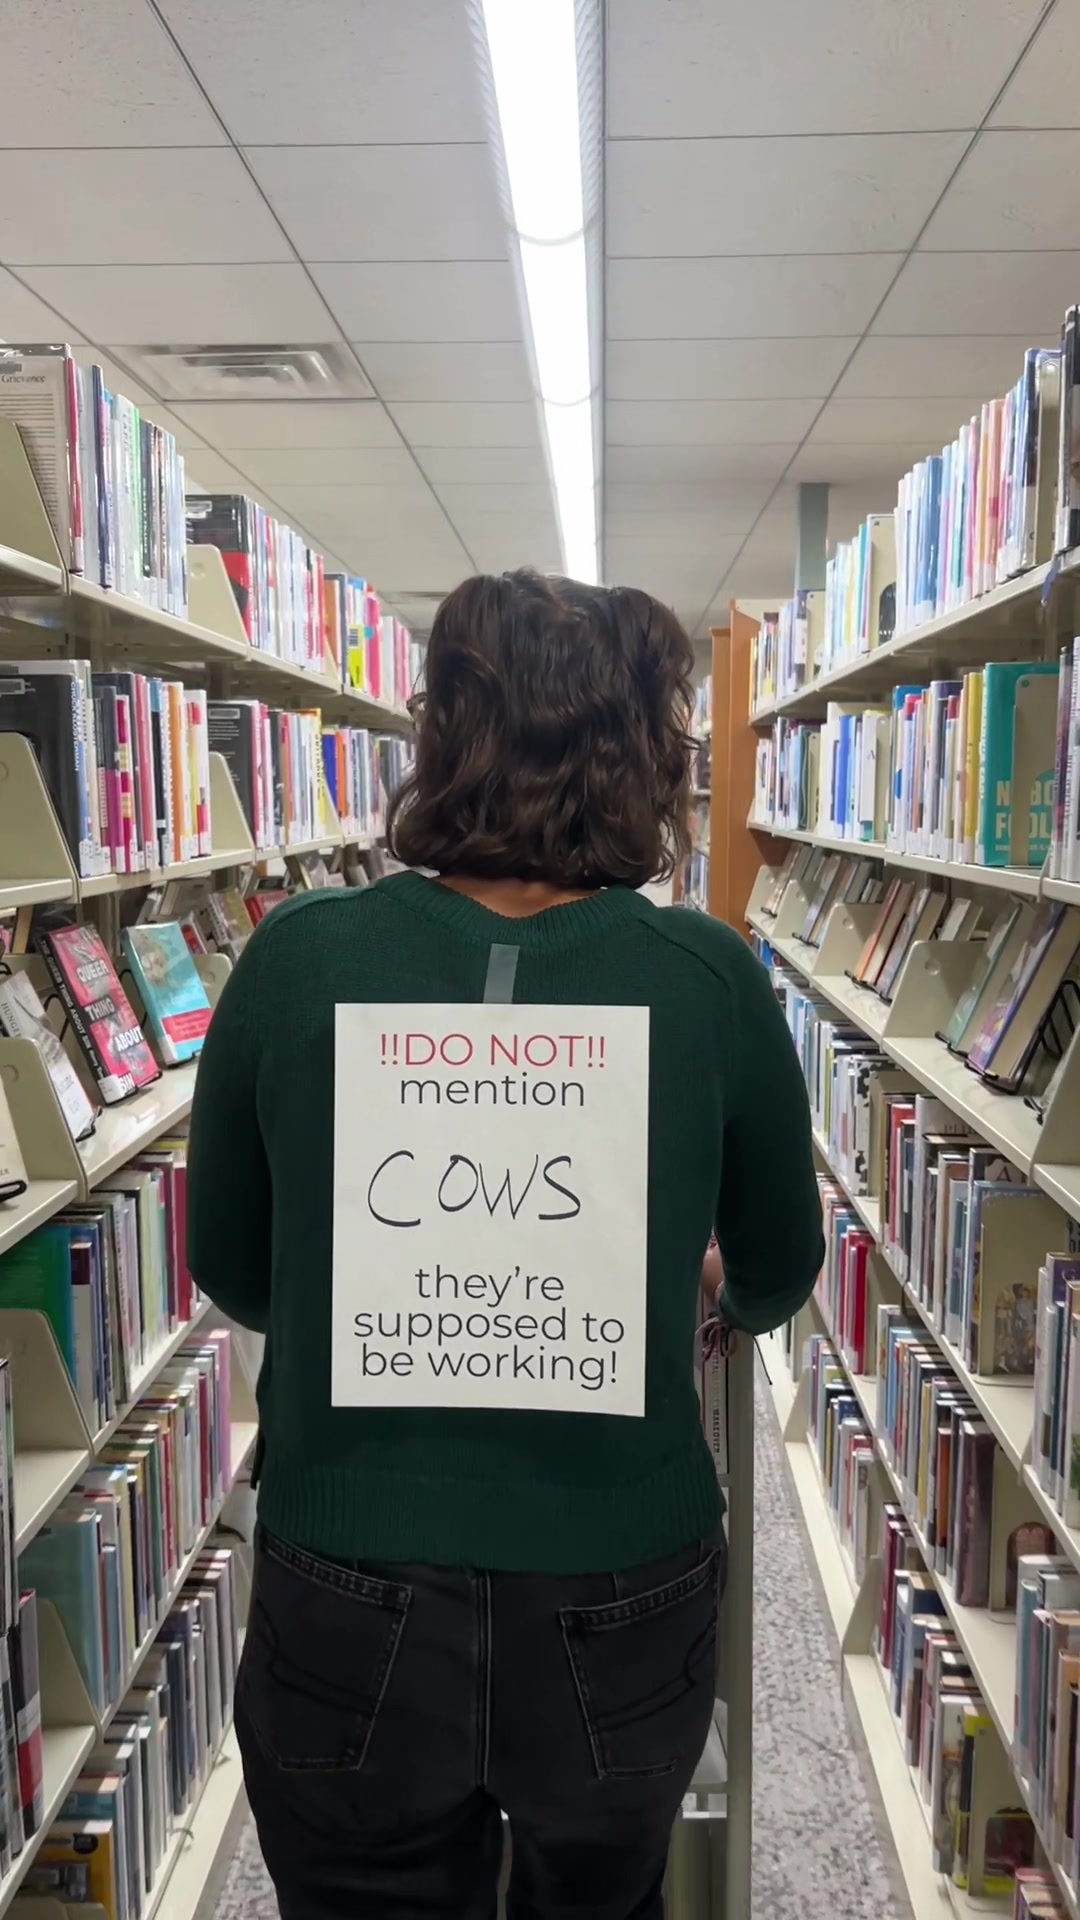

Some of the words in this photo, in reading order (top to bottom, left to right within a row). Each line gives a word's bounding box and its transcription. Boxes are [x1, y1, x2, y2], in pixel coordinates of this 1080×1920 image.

[76, 960, 110, 983] QUEER
[47, 956, 63, 984] QUEER
[60, 983, 73, 1008] THING
[69, 1008, 86, 1034] ABOUT
[81, 1034, 92, 1050] SIN
[85, 997, 116, 1022] THING
[114, 1025, 145, 1053] ABOUT
[381, 1033, 474, 1066] !!DO
[490, 1034, 605, 1068] NOT!!
[118, 1072, 136, 1094] SIN
[400, 1071, 585, 1107] mention
[367, 1149, 581, 1228] COWS
[414, 1265, 565, 1308] they're
[353, 1307, 566, 1347] supposed
[581, 1312, 625, 1344] to
[362, 1343, 414, 1377] be
[427, 1345, 617, 1391] working!
